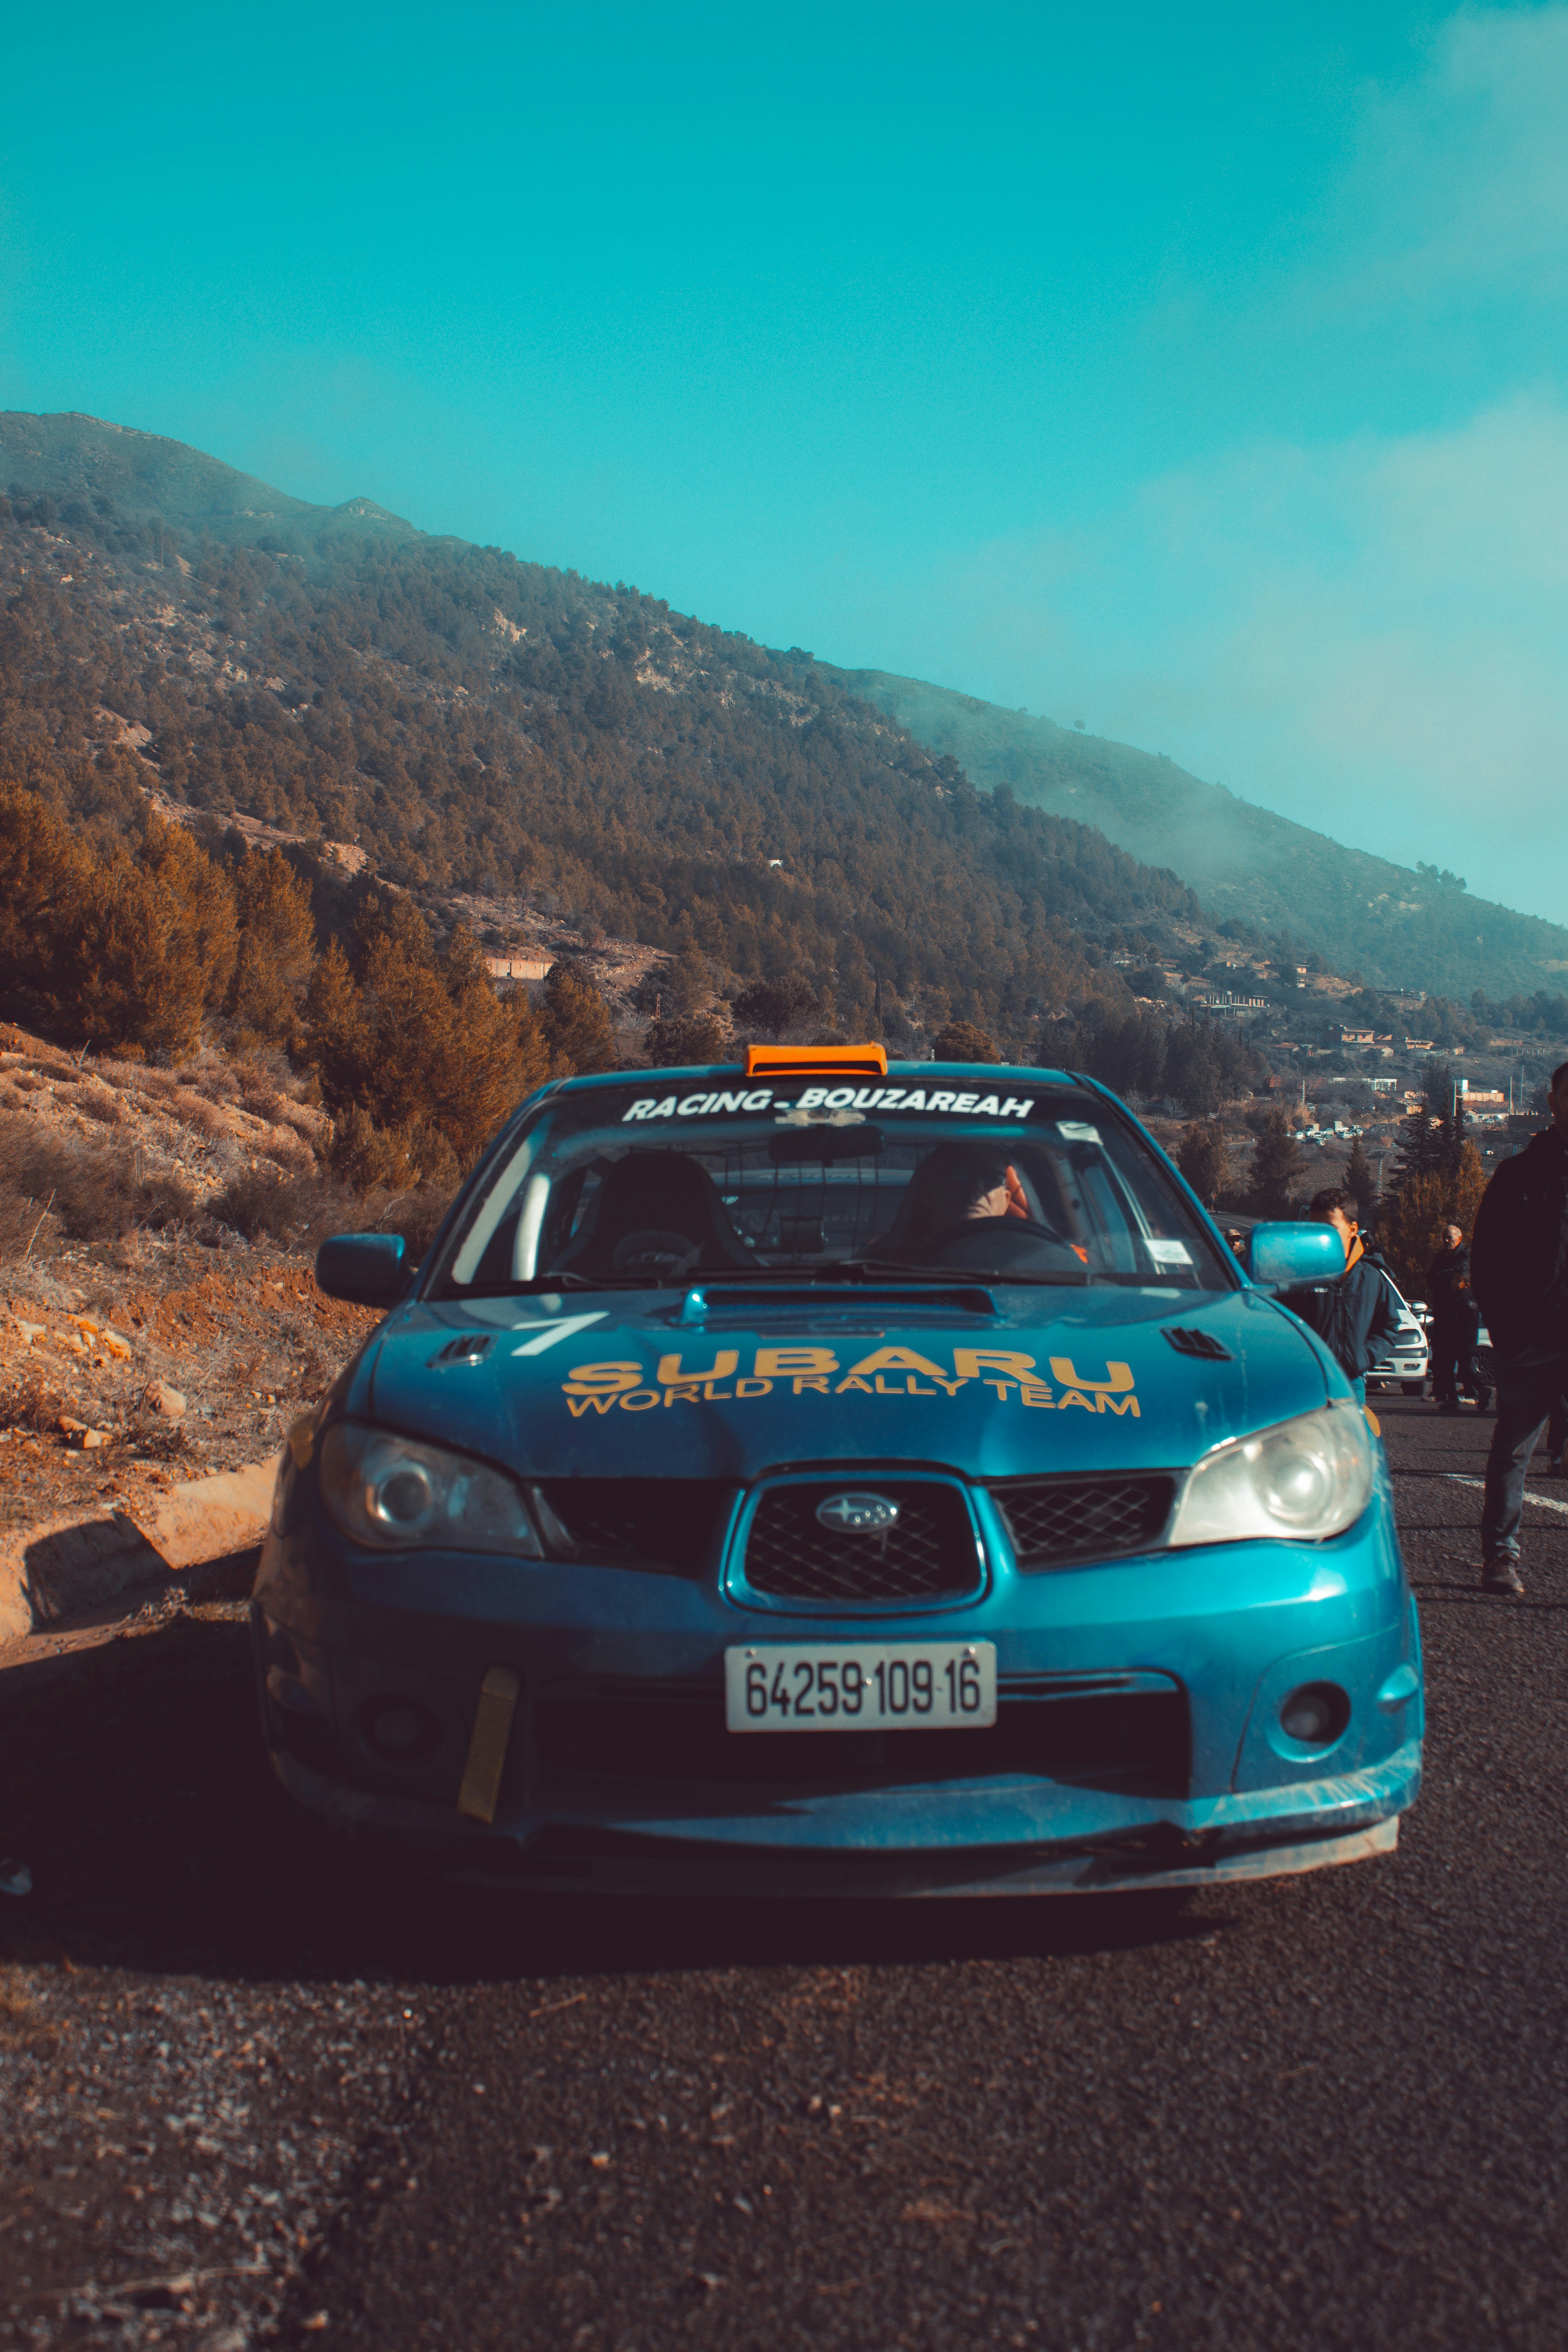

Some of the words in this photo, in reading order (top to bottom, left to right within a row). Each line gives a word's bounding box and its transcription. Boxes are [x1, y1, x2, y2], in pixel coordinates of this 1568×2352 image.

[561, 1347, 1135, 1396] SUBARU
[567, 1377, 773, 1417] WORLD
[793, 1375, 969, 1396] RALLY
[983, 1379, 1141, 1417] TEAM
[745, 1661, 862, 1718] 64259
[874, 1660, 933, 1715] 109
[945, 1658, 981, 1714] 16
